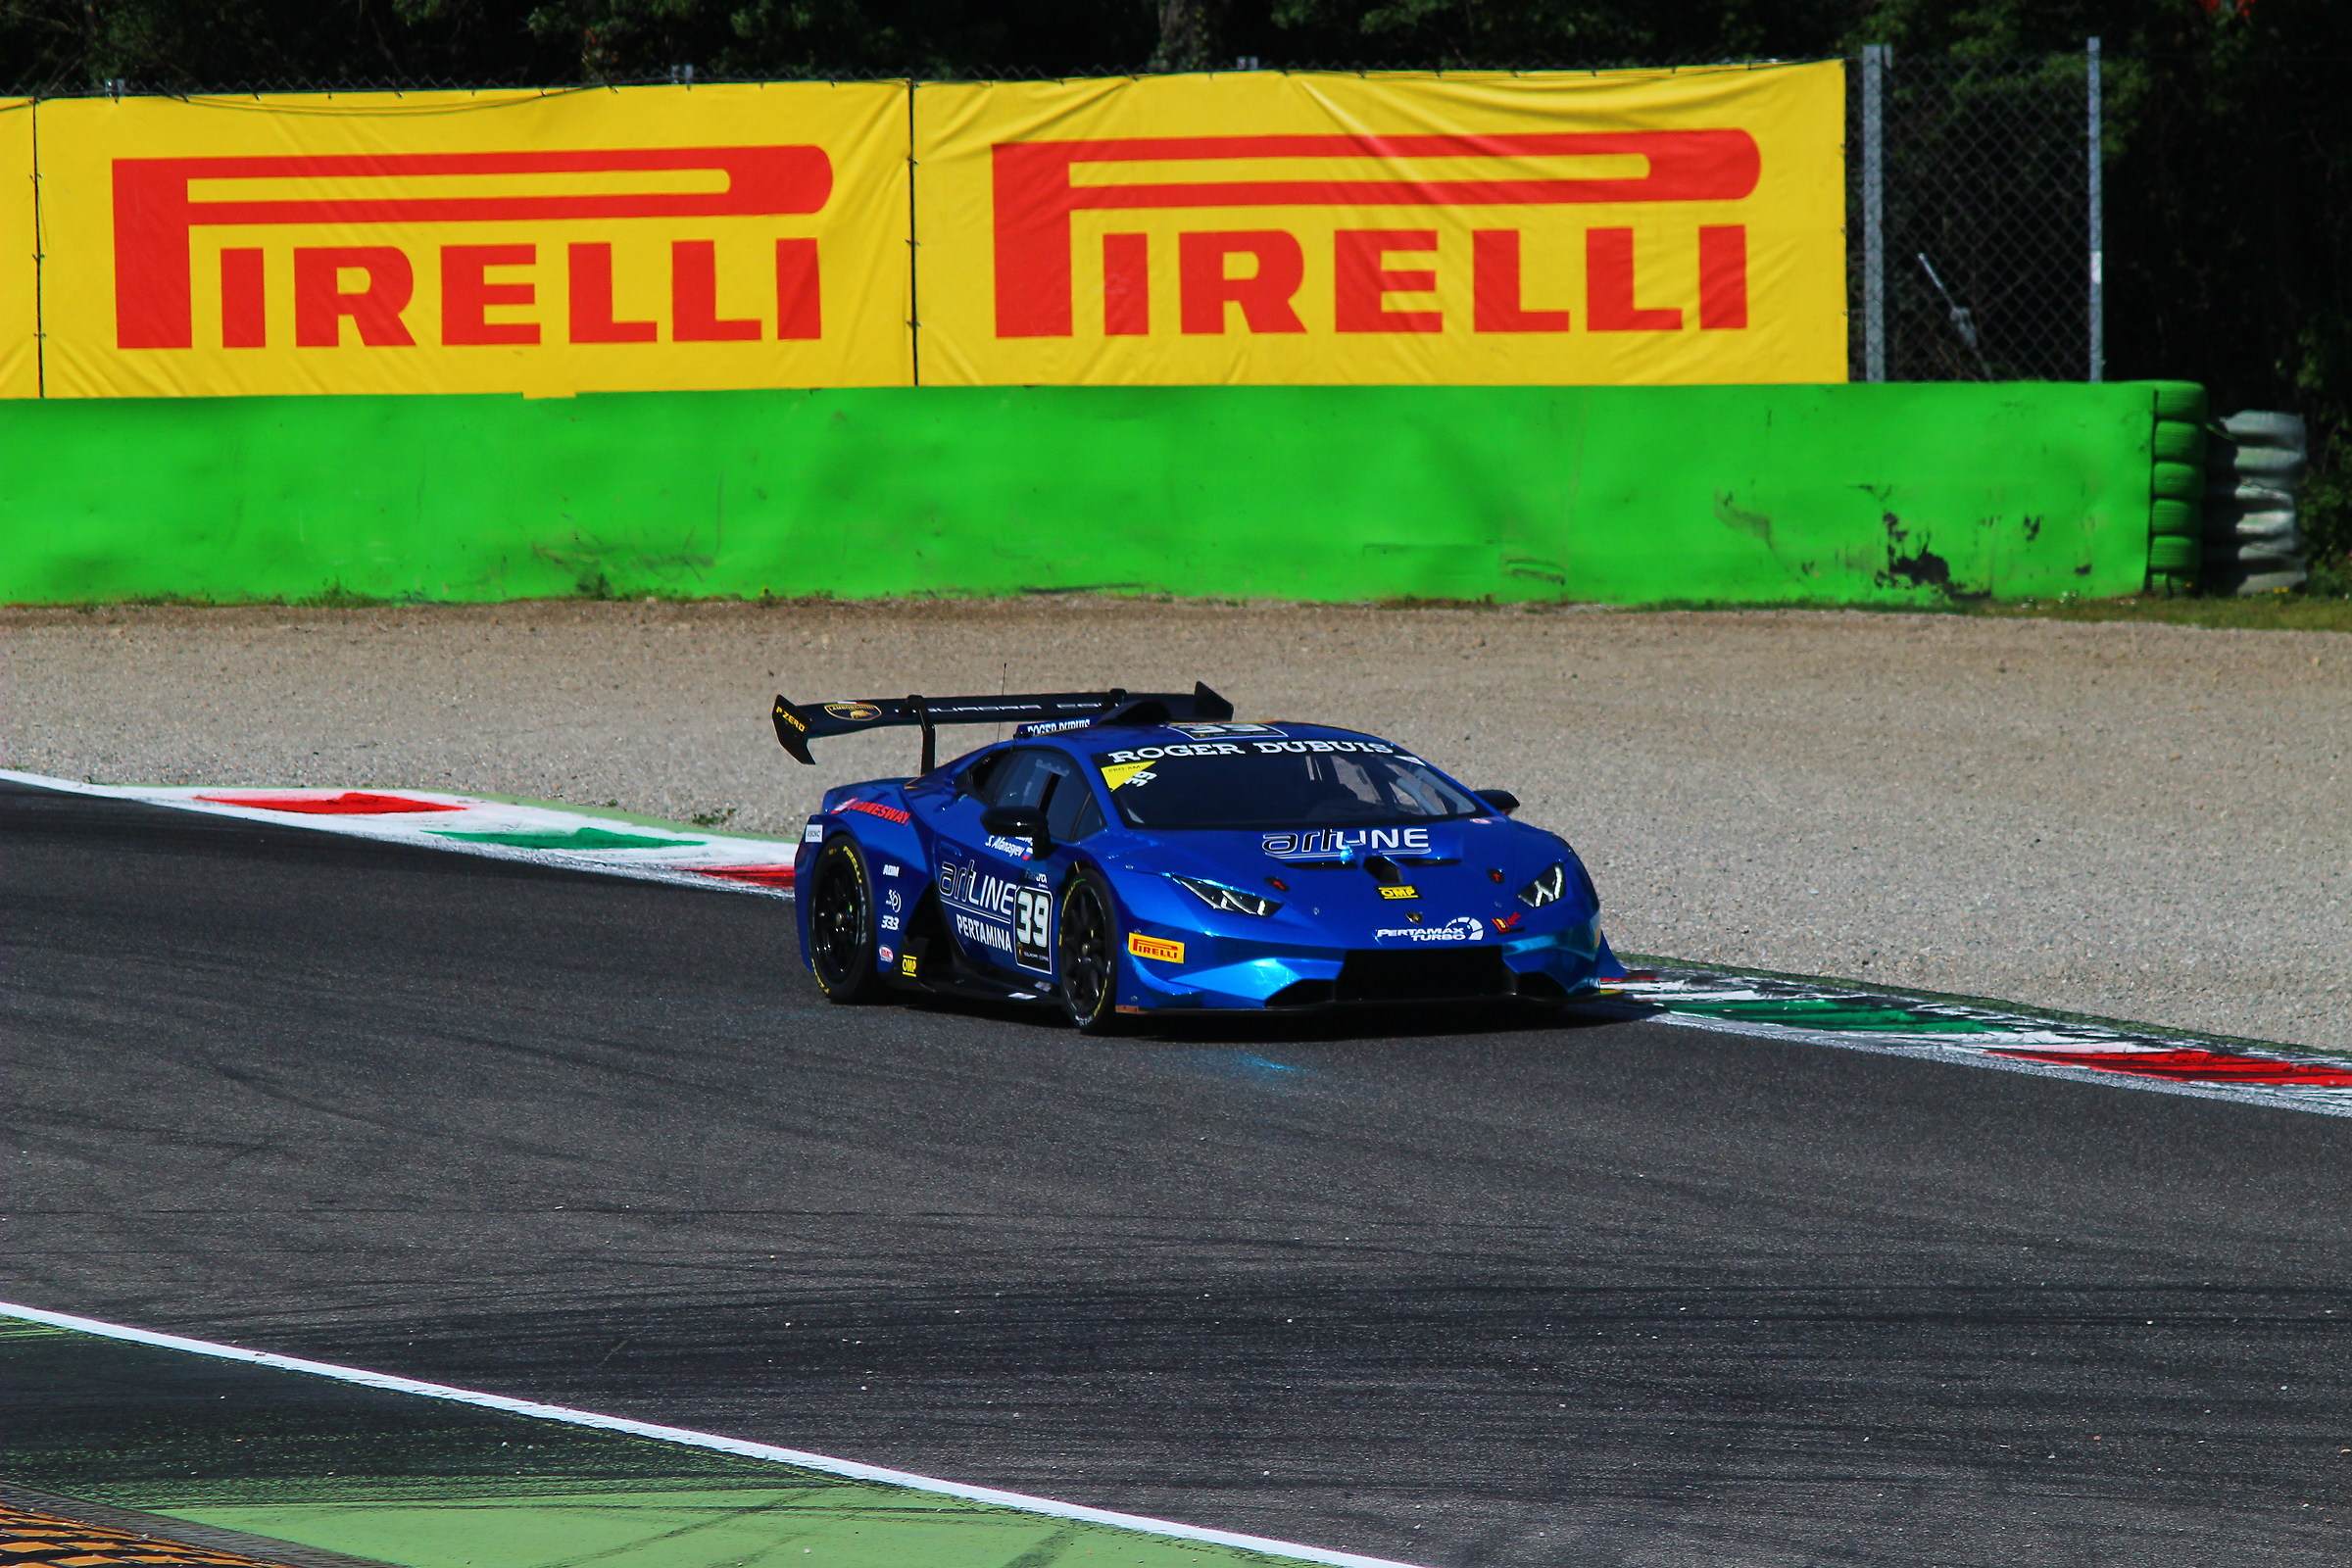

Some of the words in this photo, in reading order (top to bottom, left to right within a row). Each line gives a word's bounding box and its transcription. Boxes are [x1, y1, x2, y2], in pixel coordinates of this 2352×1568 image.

[992, 127, 1761, 338] PIRELLI
[112, 144, 833, 349] PIRELLI
[782, 711, 806, 733] ZERO
[1107, 742, 1246, 763] ROGER
[1252, 740, 1394, 755] DUBUIS
[1381, 888, 1415, 898] OMP
[1016, 891, 1049, 948] 39
[956, 913, 1012, 954] PERTAMINA
[1377, 927, 1464, 938] PERTAMAX
[1132, 938, 1178, 959] PIRELLI
[902, 957, 916, 973] OMP
